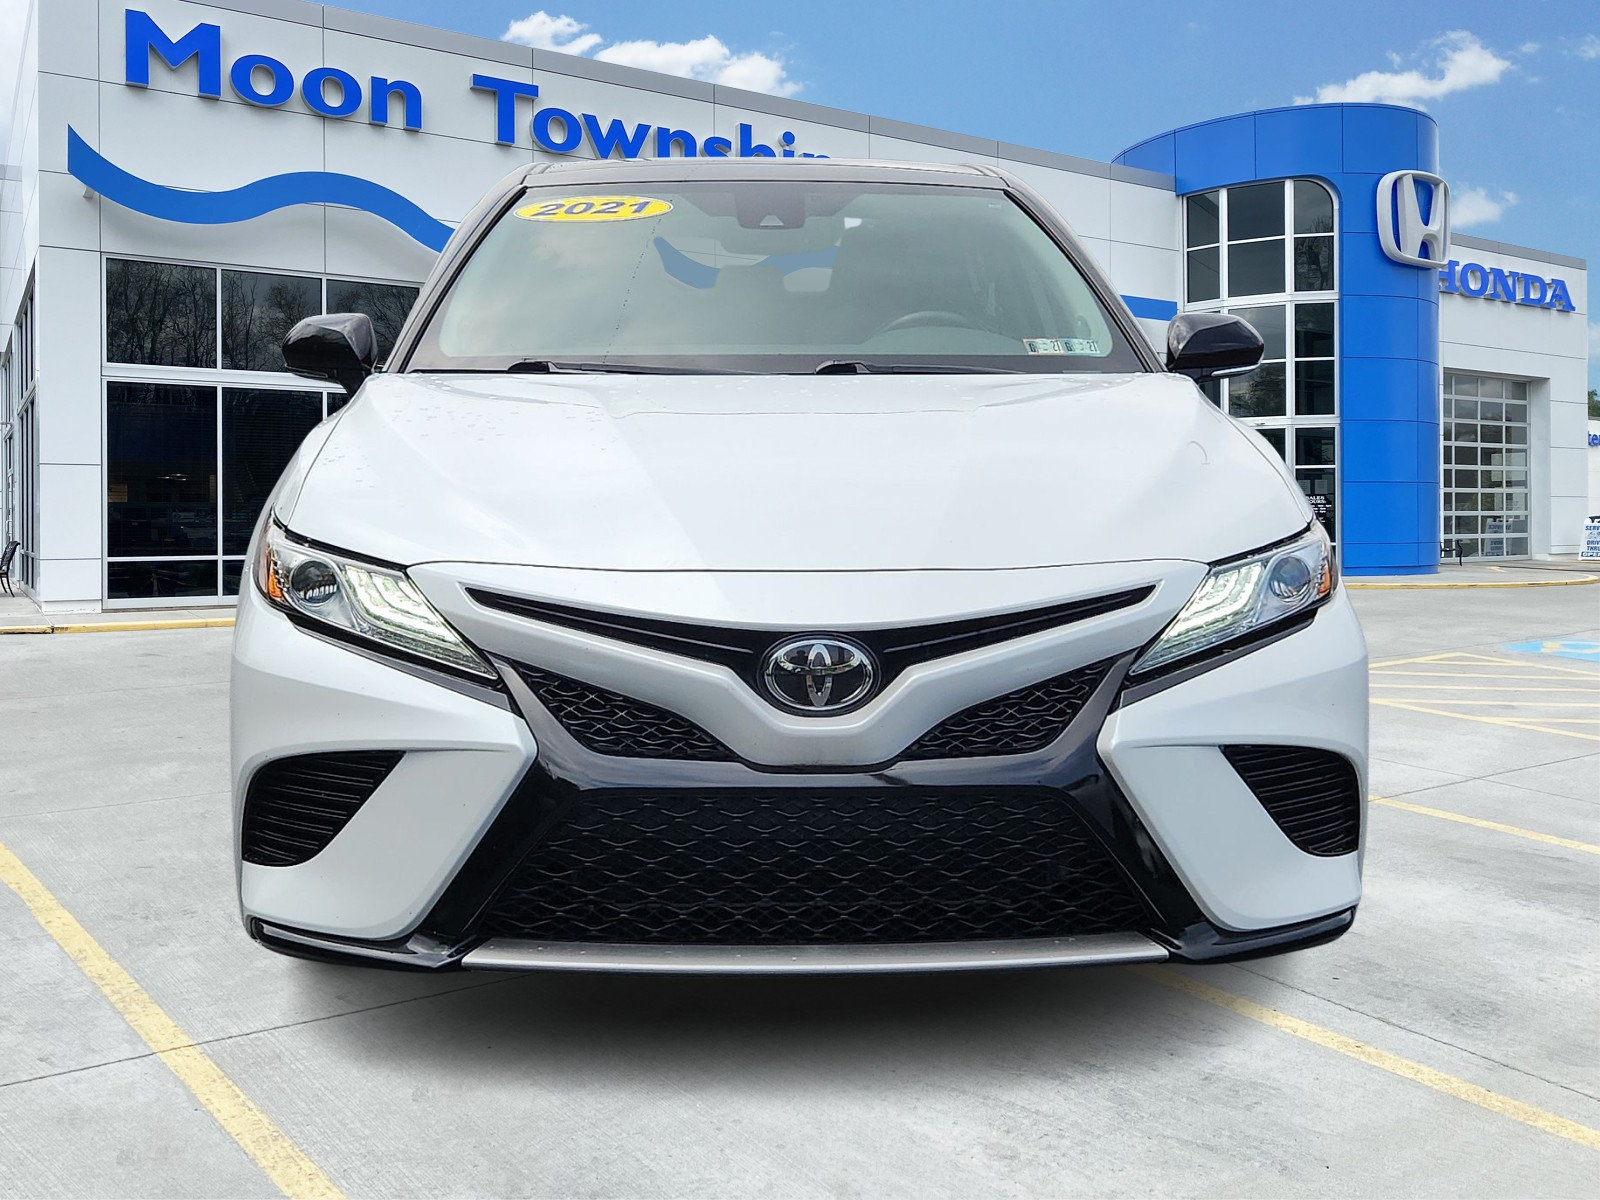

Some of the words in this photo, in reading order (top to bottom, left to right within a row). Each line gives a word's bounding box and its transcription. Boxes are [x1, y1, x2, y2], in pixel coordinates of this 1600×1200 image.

[125, 8, 422, 131] Moon
[469, 73, 832, 159] Townshi
[530, 200, 651, 216] 2021
[1438, 259, 1576, 312] HONDA
